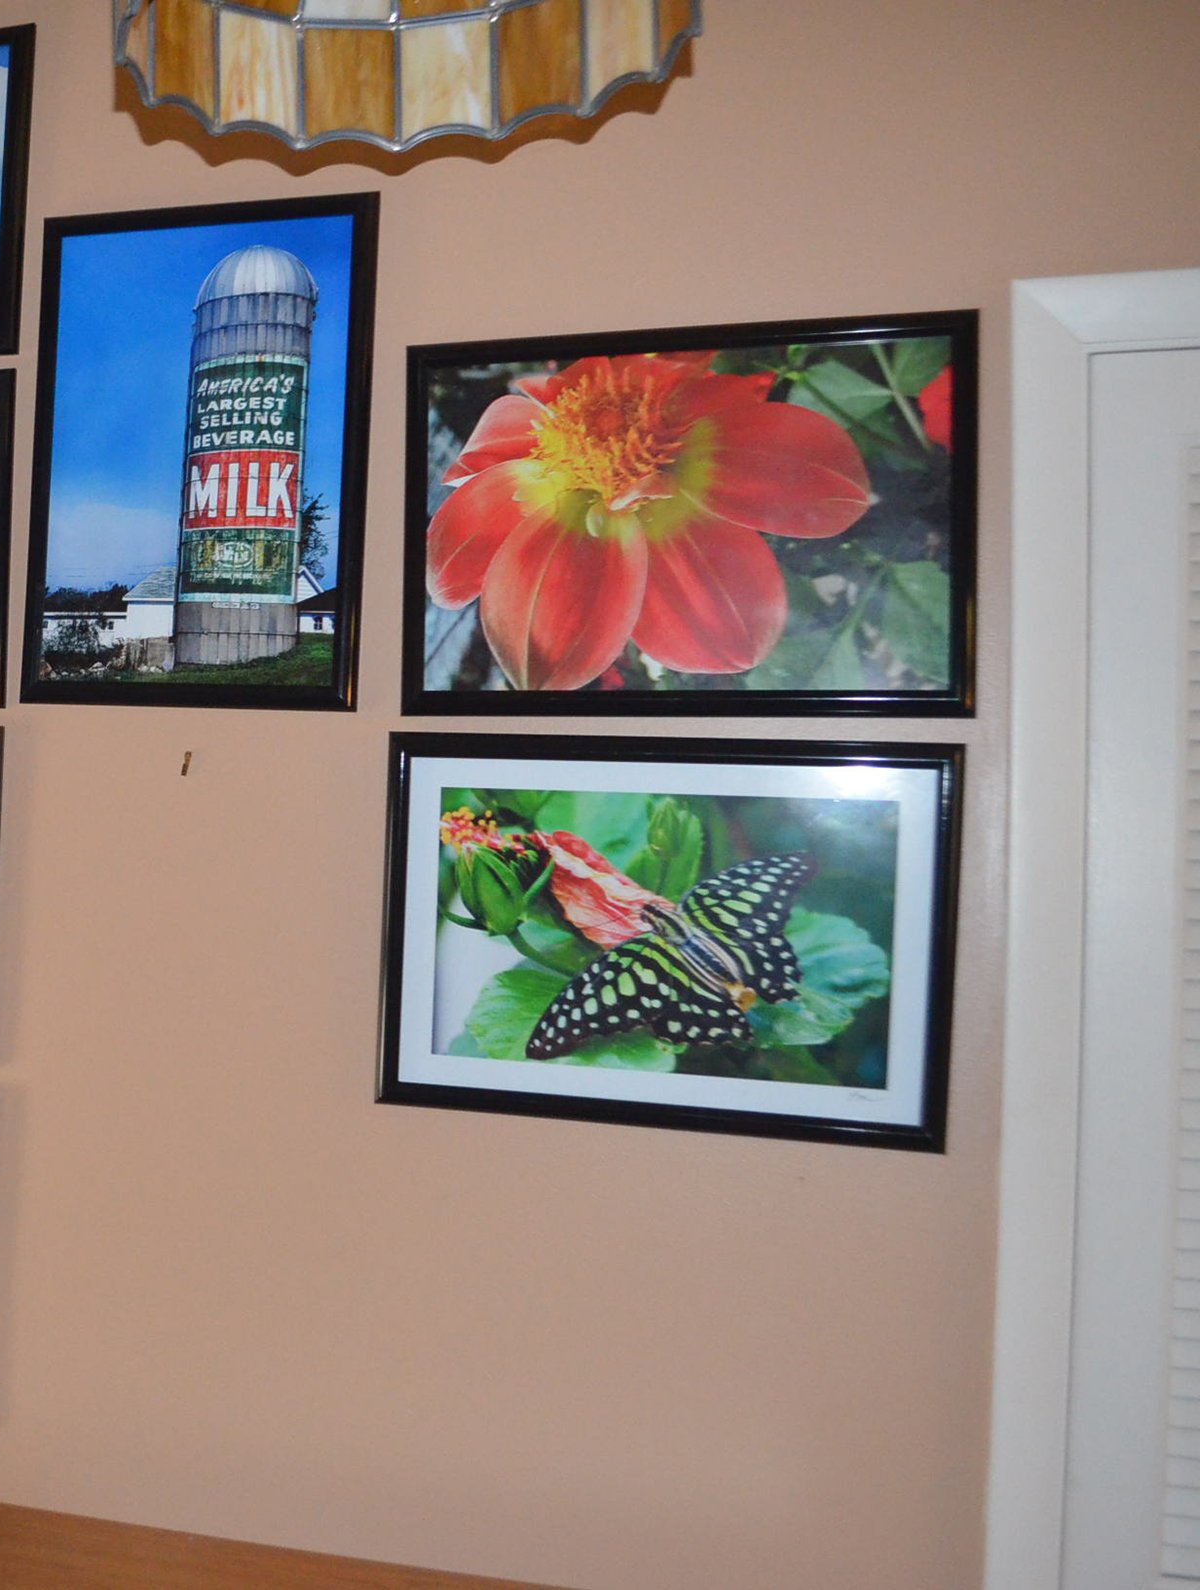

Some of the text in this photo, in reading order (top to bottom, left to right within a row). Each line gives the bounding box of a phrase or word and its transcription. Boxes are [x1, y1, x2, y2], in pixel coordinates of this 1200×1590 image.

[197, 373, 294, 397] AMERICA'S
[197, 397, 287, 414] LARGEST
[199, 411, 283, 429] SELLING
[193, 429, 295, 449] BEVERAGE
[188, 461, 295, 519] MILK
